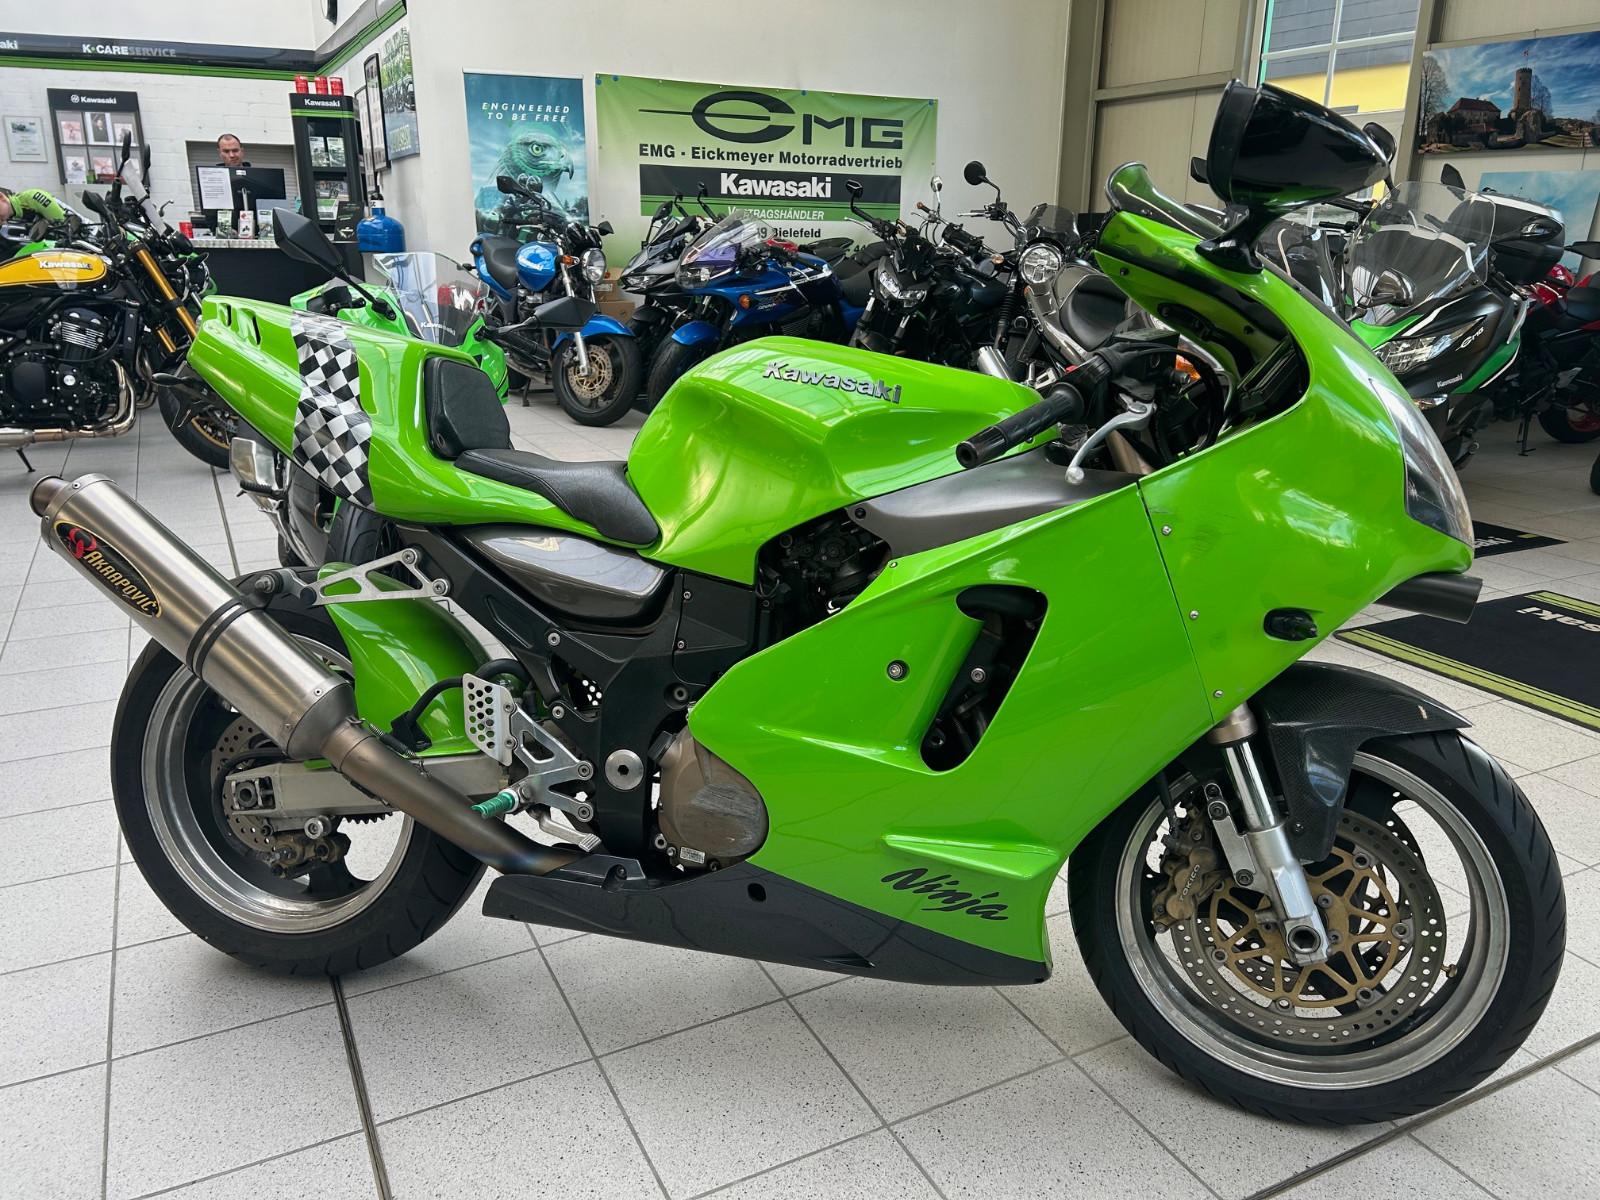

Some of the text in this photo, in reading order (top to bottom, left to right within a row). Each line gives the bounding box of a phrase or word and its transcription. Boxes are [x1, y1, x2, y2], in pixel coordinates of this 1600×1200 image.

[81, 96, 117, 105] Kawasaki
[304, 98, 341, 107] Kawasaki
[482, 102, 570, 114] ENGINEERED
[488, 112, 567, 123] TO BE FREE
[639, 143, 676, 159] EMG
[691, 146, 775, 165] Eickmeyer
[779, 151, 903, 169] Motorradvertrieb
[720, 172, 832, 198] Kawasaki
[728, 206, 825, 220] VTRAGSHÄNDLER
[774, 227, 822, 239] Bielefeld
[762, 361, 902, 405] Kawasaki
[1179, 864, 1200, 903] TOKICO
[881, 868, 1009, 921] Ninja
